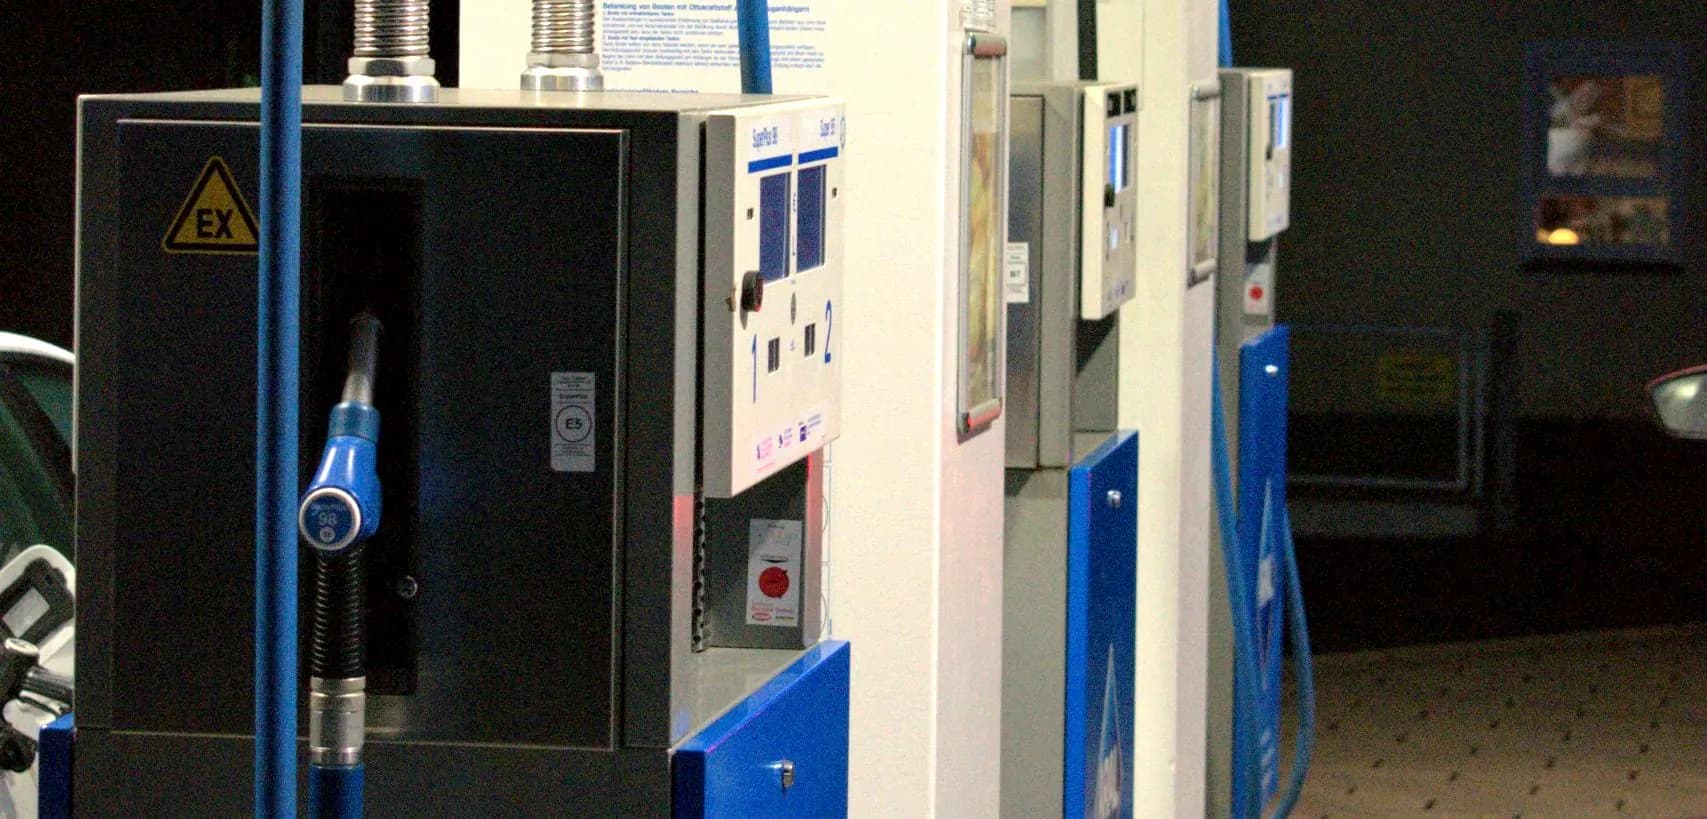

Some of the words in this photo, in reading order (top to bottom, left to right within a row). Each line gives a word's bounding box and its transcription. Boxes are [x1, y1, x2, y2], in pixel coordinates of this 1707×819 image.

[602, 2, 637, 10] Betankung
[197, 208, 233, 239] EX
[824, 299, 833, 364] 2
[752, 333, 757, 404] 1
[565, 418, 583, 430] E5
[319, 511, 337, 526] 98
